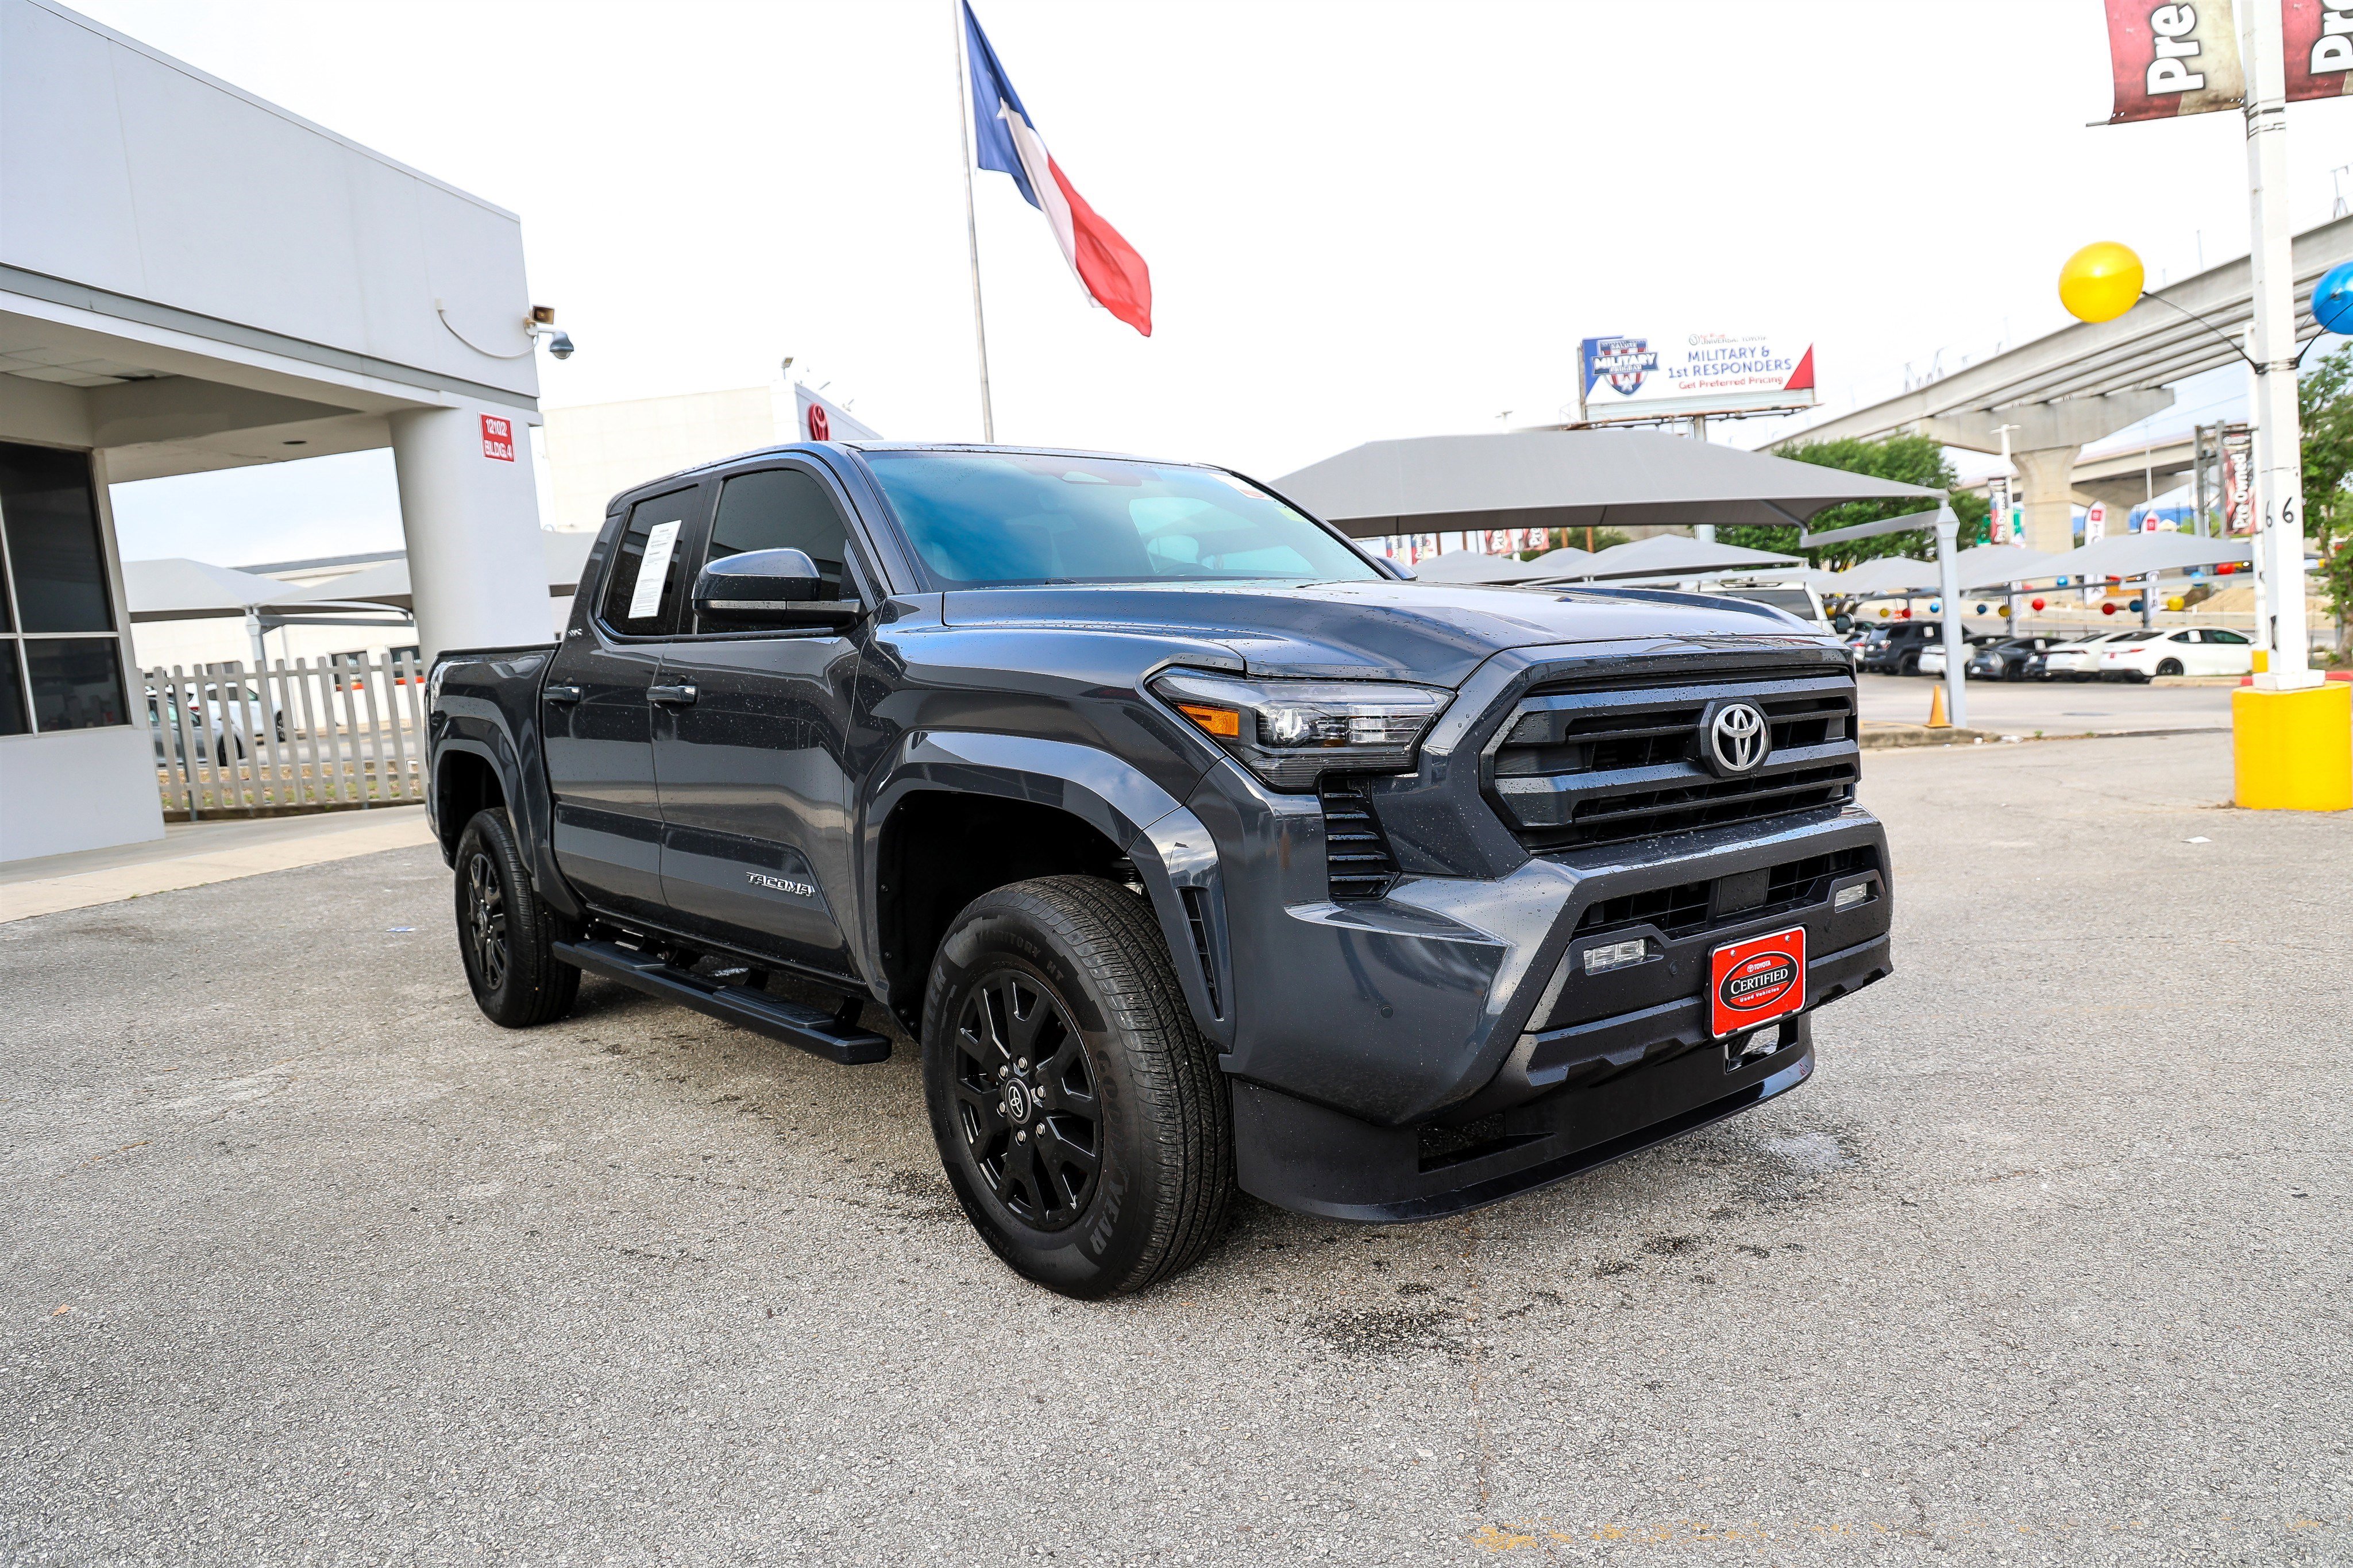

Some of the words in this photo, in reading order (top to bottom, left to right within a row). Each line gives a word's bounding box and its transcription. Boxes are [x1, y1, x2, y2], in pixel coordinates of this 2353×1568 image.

[2147, 3, 2205, 95] Pre
[1594, 353, 1656, 369] MILITARY
[1688, 346, 1756, 362] MILITARY
[1761, 346, 1769, 357] &
[1668, 367, 1689, 379] 1st
[1693, 358, 1792, 376] RESPONDERS
[1679, 381, 1696, 389] Get
[1700, 377, 1746, 388] Preferred
[1749, 376, 1784, 385] Pricing
[485, 418, 508, 437] 12102
[2229, 453, 2248, 503] Owned
[2232, 504, 2250, 530] Pre
[2266, 500, 2273, 528] 6
[2283, 496, 2294, 524] 6
[746, 871, 816, 898] TACOMA
[1754, 960, 1772, 970] TOYOTA
[1730, 968, 1788, 995] CERTIFIED
[1739, 994, 1754, 1002] Used
[1756, 987, 1780, 998] Vehicles
